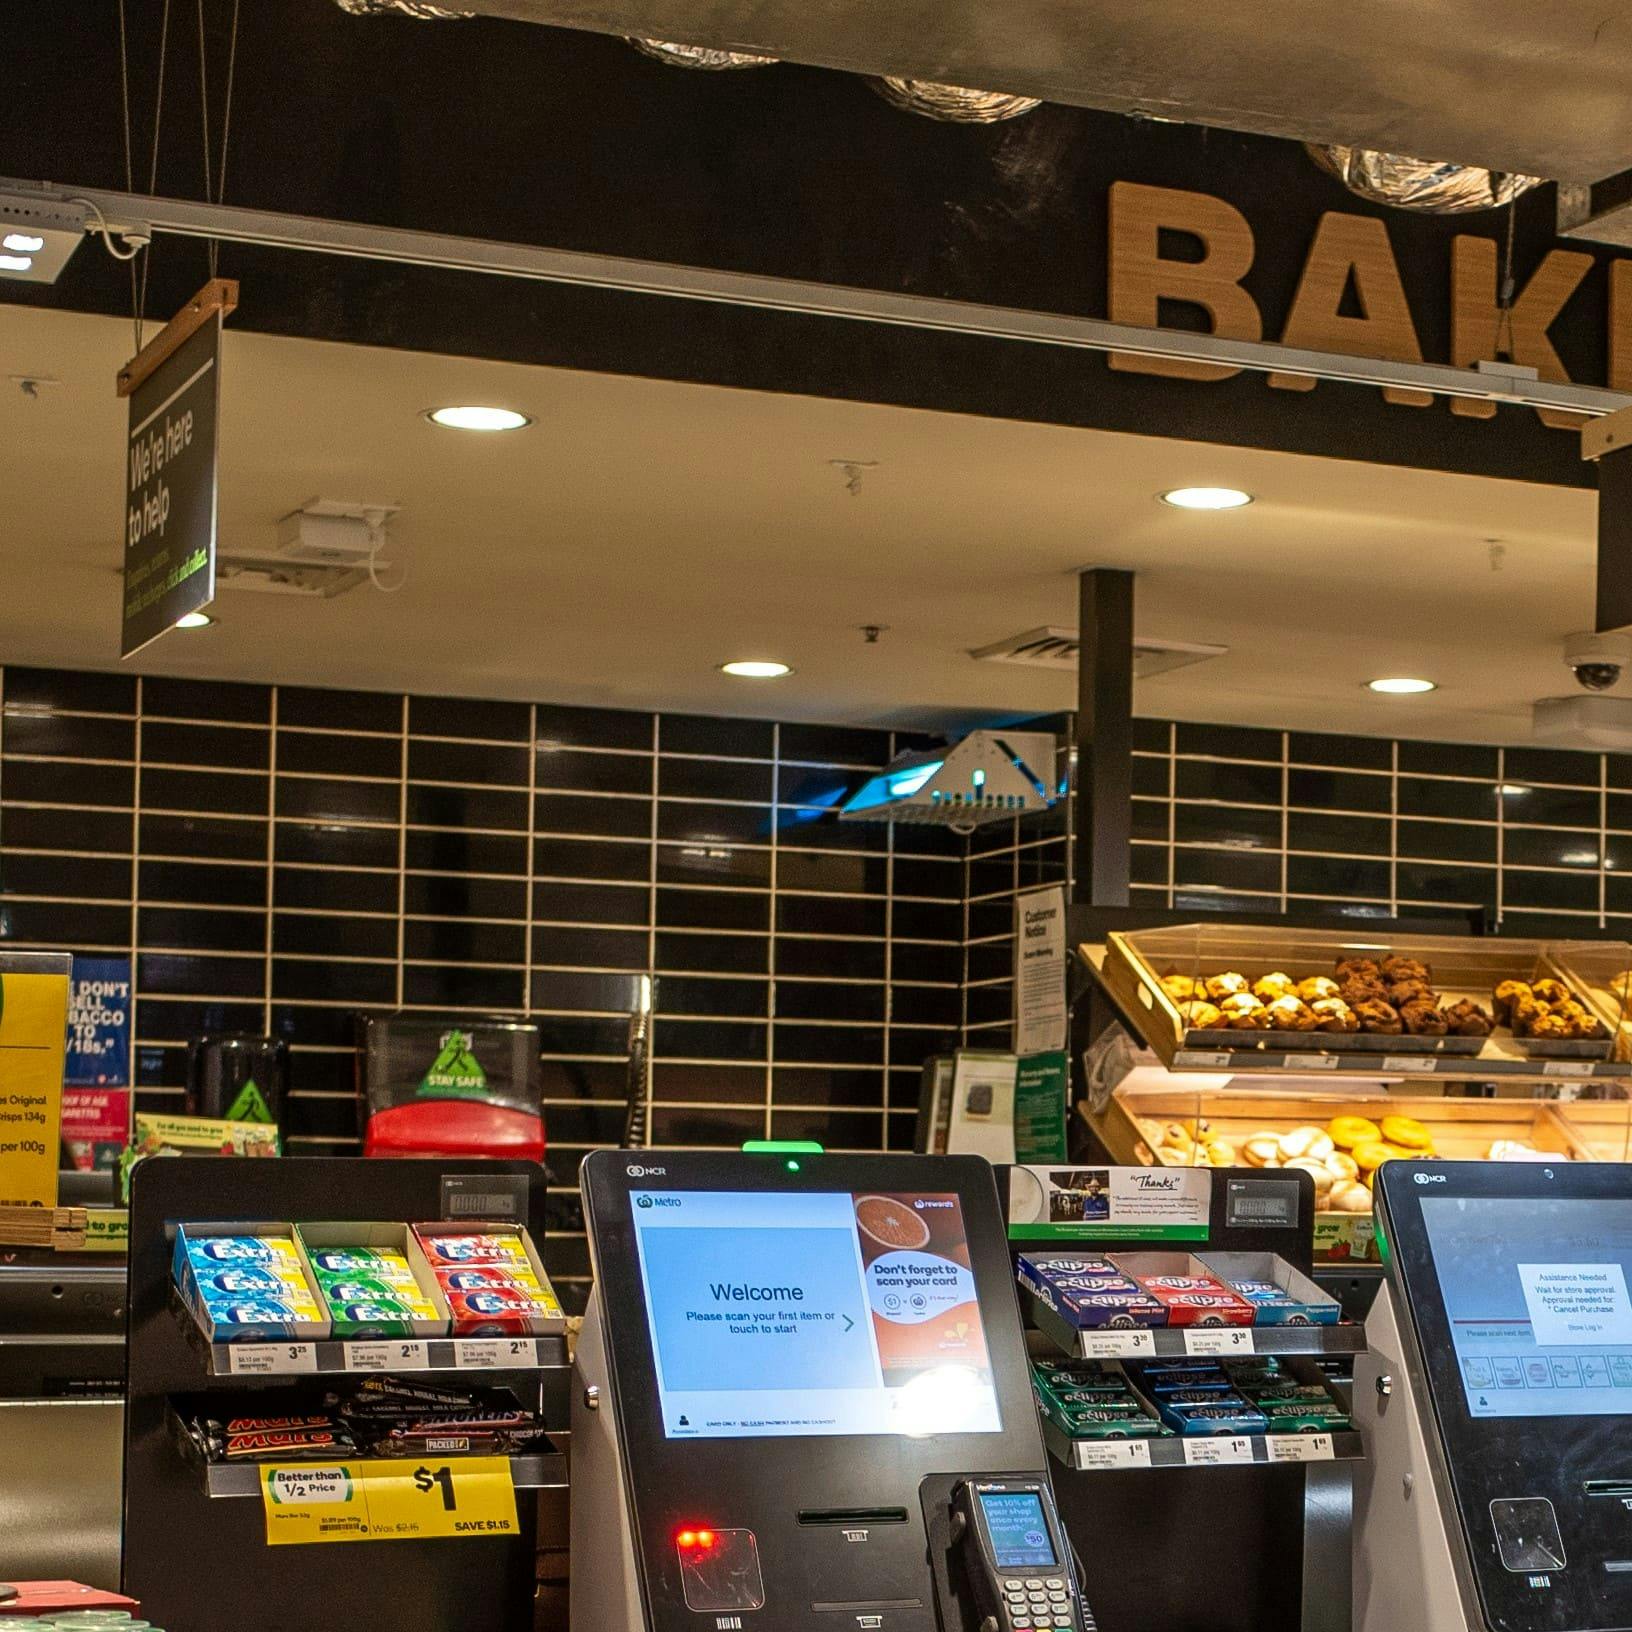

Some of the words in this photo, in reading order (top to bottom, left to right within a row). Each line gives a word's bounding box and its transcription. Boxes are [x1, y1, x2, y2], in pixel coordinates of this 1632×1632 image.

[131, 430, 164, 491] We're
[166, 409, 193, 463] here
[129, 505, 141, 546] to
[144, 479, 170, 536] help
[79, 982, 129, 998] DON'T
[67, 1010, 125, 1026] BACCO
[74, 1025, 96, 1038] TO
[428, 1076, 455, 1087] STAY
[456, 1077, 482, 1088] SAFE
[9, 1094, 47, 1107] Original
[24, 1111, 46, 1125] 134g
[1, 1144, 19, 1155] per
[20, 1141, 46, 1155] 100g
[645, 1167, 666, 1175] NCR
[655, 1197, 681, 1207] Metro
[924, 1200, 954, 1208] rewards
[92, 1221, 106, 1231] to
[213, 1244, 287, 1260] Extra
[445, 1243, 514, 1259] Extra
[325, 1255, 398, 1270] Extra
[1036, 1260, 1104, 1273] eclipse
[874, 1264, 907, 1275] Don't
[909, 1264, 944, 1276] forget
[946, 1264, 958, 1274] to
[224, 1275, 297, 1291] Extra
[461, 1275, 530, 1290] Extra
[876, 1277, 904, 1286] scan
[906, 1277, 930, 1288] your
[932, 1275, 958, 1286] card
[1056, 1277, 1125, 1289] eclipse
[1145, 1276, 1211, 1288] eclipse
[1539, 1273, 1577, 1281] Assistance
[1578, 1273, 1607, 1281] Needed
[339, 1287, 412, 1301] Extra
[709, 1283, 804, 1301] Welcome
[1535, 1286, 1552, 1294] Wait
[1564, 1286, 1582, 1294] store
[478, 1295, 548, 1310] Extra
[1078, 1295, 1148, 1307] eclipse
[1167, 1295, 1233, 1306] eclipse
[1542, 1296, 1574, 1305] Approval
[1575, 1295, 1601, 1303] needed
[355, 1309, 429, 1320] Extra
[1553, 1305, 1579, 1313] Cancel
[1580, 1305, 1614, 1313] Purchase
[237, 1308, 312, 1323] Extra
[686, 1311, 723, 1321] Please
[725, 1313, 750, 1321] scan
[753, 1313, 776, 1323] your
[778, 1311, 797, 1321] first
[799, 1311, 822, 1320] item
[824, 1312, 835, 1320] or
[729, 1324, 759, 1333] touch
[761, 1324, 772, 1333] to
[774, 1324, 797, 1333] start
[1078, 1410, 1129, 1422] eclipse
[1272, 1405, 1321, 1417] eclipse
[277, 1471, 314, 1482] Better
[316, 1470, 342, 1481] than
[285, 1483, 306, 1498] 1/2
[309, 1482, 336, 1494] Price
[413, 1465, 457, 1511] $1
[986, 1499, 1002, 1507] Get
[987, 1509, 1007, 1517] your
[1009, 1508, 1031, 1516] shop
[373, 1525, 394, 1533] Was
[455, 1521, 485, 1531] SAVE
[487, 1520, 510, 1530] $1.15
